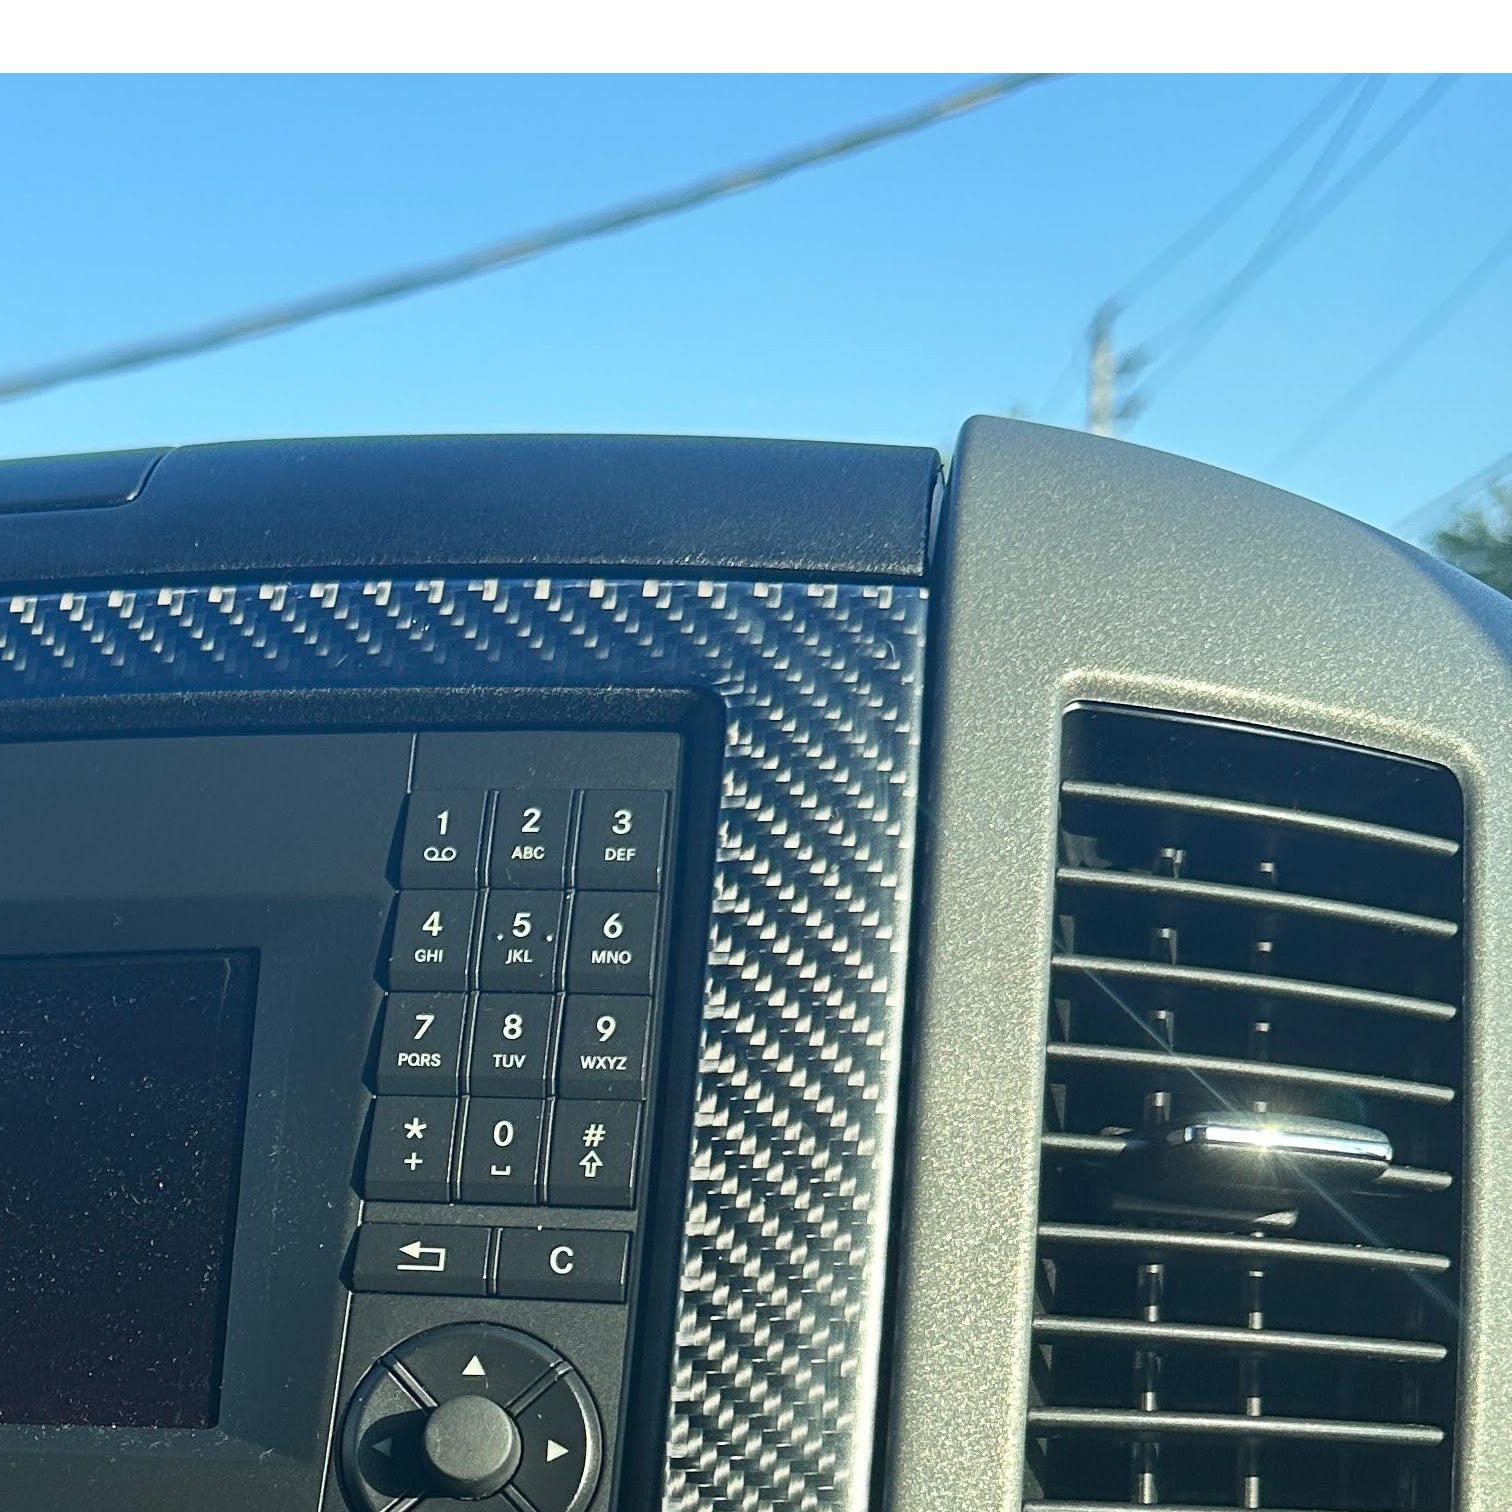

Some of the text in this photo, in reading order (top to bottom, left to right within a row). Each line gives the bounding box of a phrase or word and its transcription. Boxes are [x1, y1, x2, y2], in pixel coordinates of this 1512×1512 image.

[437, 810, 449, 835] 1
[521, 808, 542, 833] 2
[611, 809, 633, 835] 3
[511, 847, 545, 860] ABC
[604, 848, 636, 861] DEF
[422, 911, 443, 937] 4
[512, 913, 531, 938] 5
[603, 913, 623, 939] 6
[414, 949, 443, 963] GHI
[505, 950, 533, 964] JKL
[591, 951, 632, 965] MNO
[414, 1014, 435, 1040] 7
[502, 1014, 523, 1039] 8
[596, 1015, 617, 1042] 9
[397, 1053, 441, 1067] PQRS
[493, 1054, 526, 1069] TUV
[580, 1056, 627, 1070] WXYZ
[493, 1120, 514, 1147] 0
[582, 1123, 606, 1147] #
[549, 1246, 574, 1274] C
